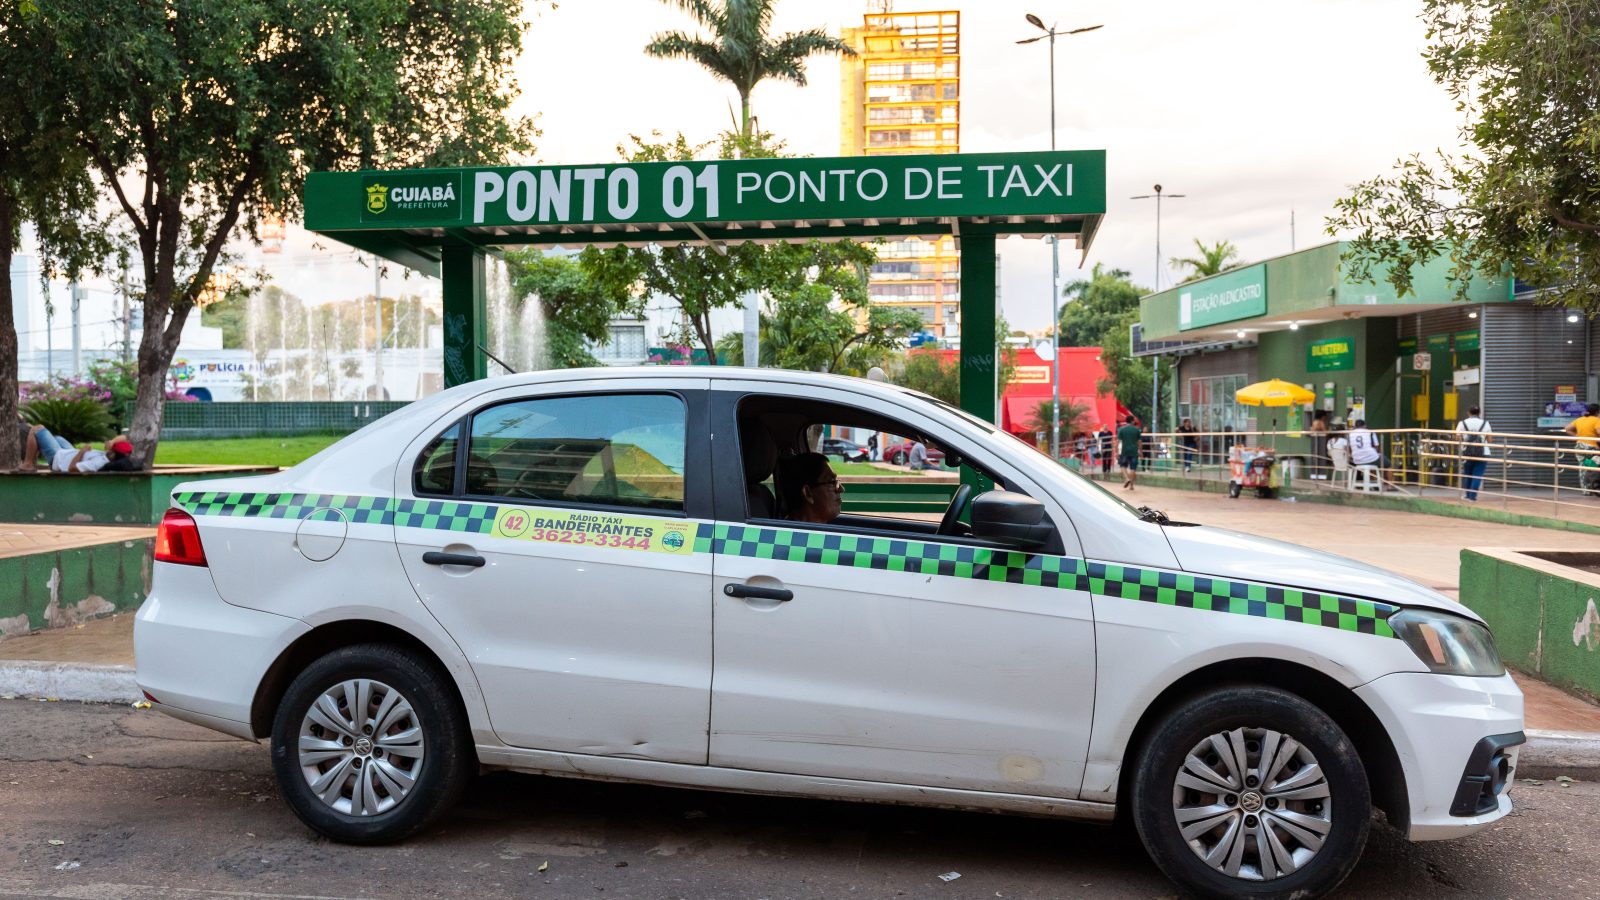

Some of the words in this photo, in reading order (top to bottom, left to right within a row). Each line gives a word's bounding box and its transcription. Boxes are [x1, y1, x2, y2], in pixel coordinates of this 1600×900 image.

[391, 182, 456, 202] CUIABÁ
[736, 168, 888, 204] PONTO
[904, 166, 963, 200] DE
[977, 163, 1073, 198] TAXI
[473, 167, 639, 223] PONTO
[662, 165, 719, 219] 01
[398, 201, 448, 209] PREFEITURA
[1193, 292, 1219, 312] ESTAÇÃO
[1219, 283, 1261, 306] ALENCASTRO
[1355, 436, 1364, 449] 9
[504, 515, 523, 531] 42
[534, 518, 653, 537] BANDEIRANTES
[569, 513, 598, 523] RÁDIO
[601, 516, 623, 525] TAXI
[531, 528, 651, 550] 3623-3344
